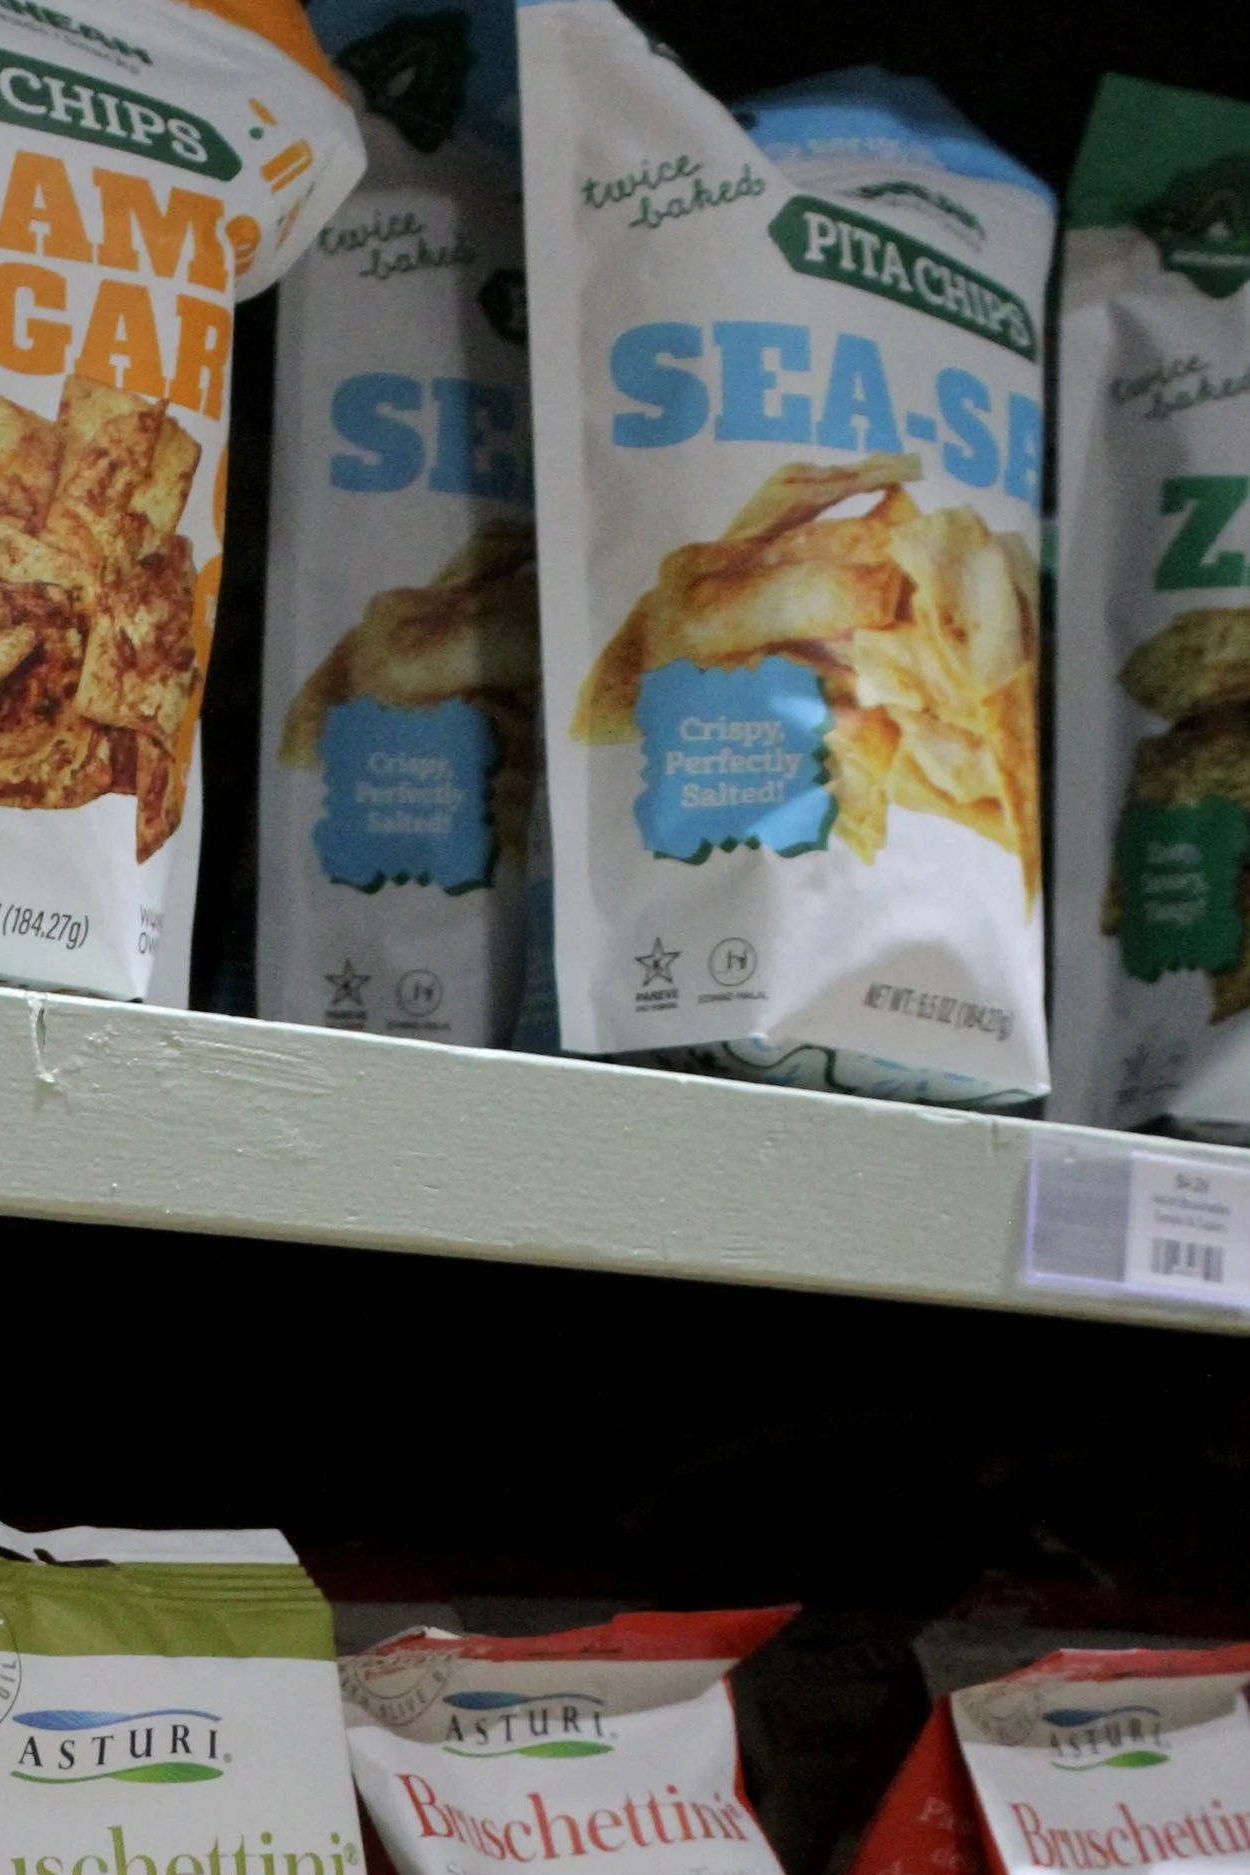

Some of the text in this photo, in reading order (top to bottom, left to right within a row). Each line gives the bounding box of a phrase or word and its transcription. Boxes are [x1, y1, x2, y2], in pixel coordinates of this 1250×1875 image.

[582, 155, 703, 209] twice
[629, 163, 766, 229] baked
[317, 209, 427, 254] twice
[802, 212, 1032, 347] PITA CHIPS
[680, 717, 786, 749] Crispy,
[666, 749, 803, 778] Perfectly
[681, 780, 786, 808] Salted!
[2, 899, 89, 949] (184.27g)
